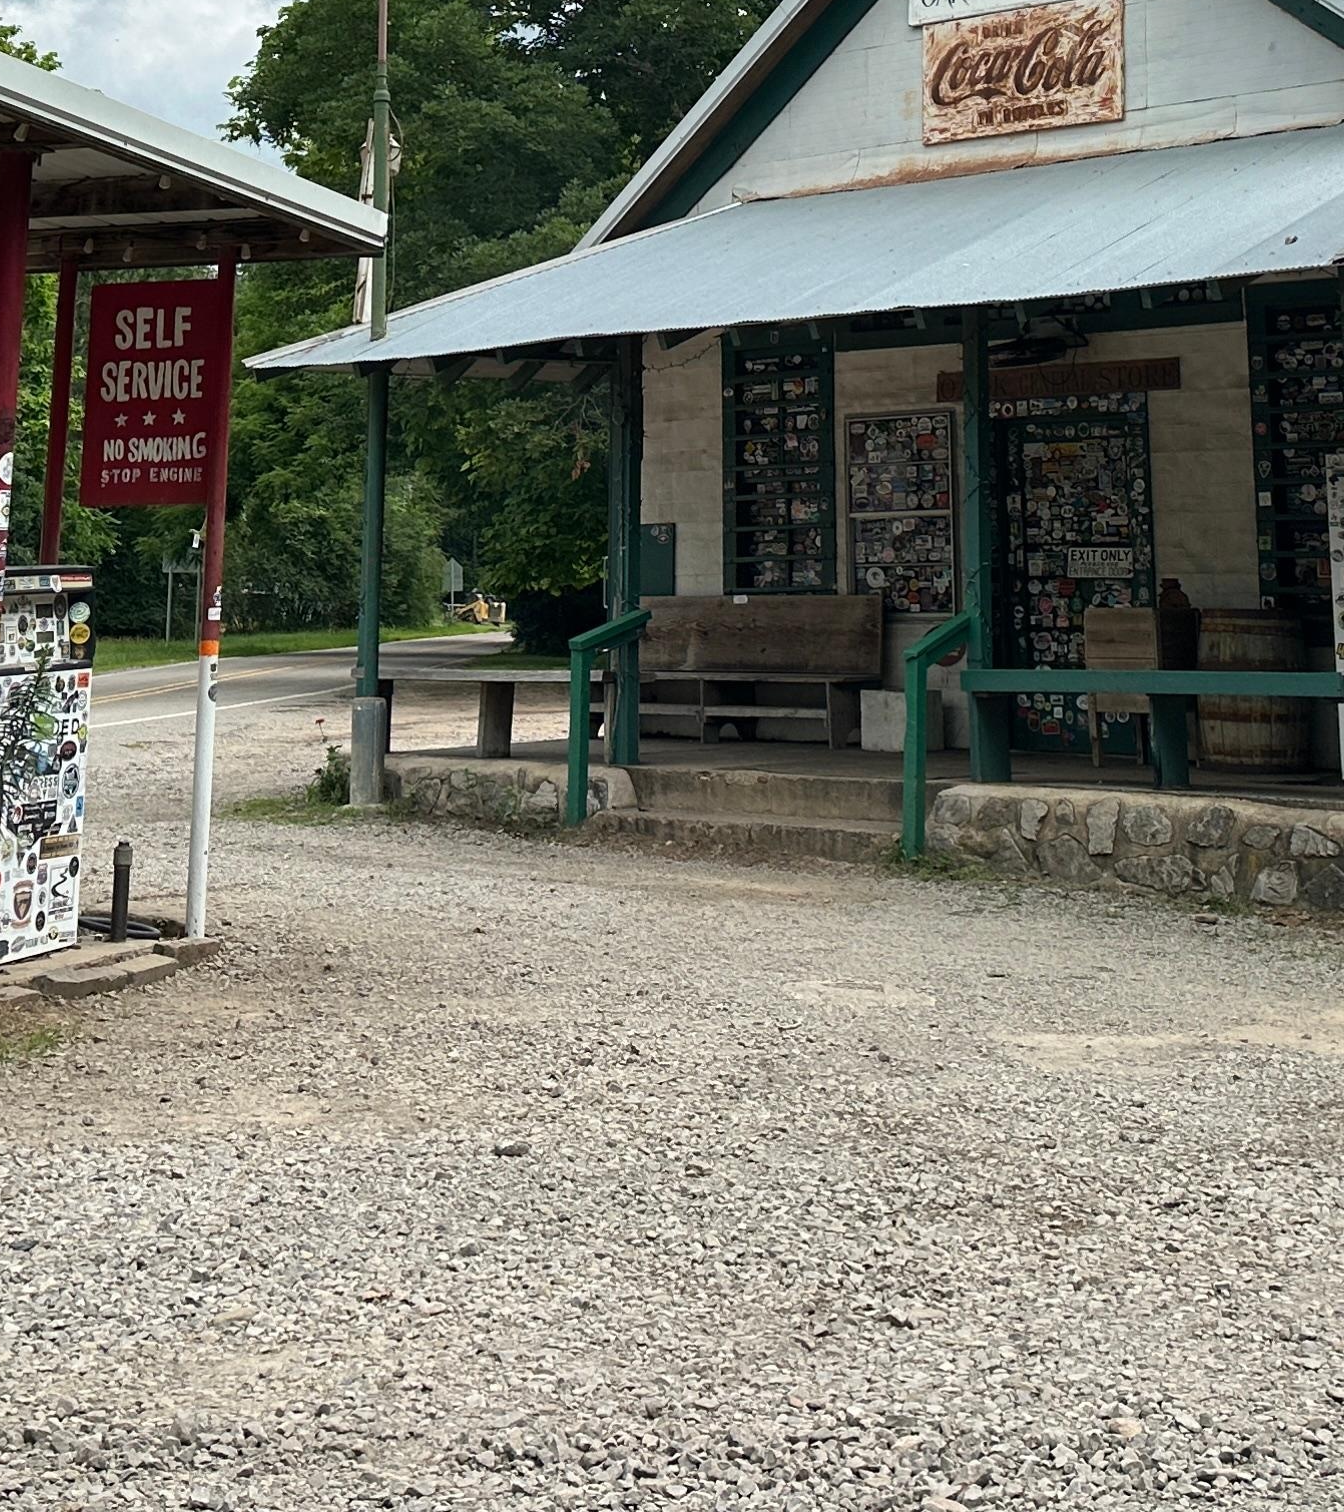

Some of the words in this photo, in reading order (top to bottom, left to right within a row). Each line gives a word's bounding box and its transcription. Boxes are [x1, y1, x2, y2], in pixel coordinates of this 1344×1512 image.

[114, 306, 193, 350] SELF
[100, 359, 205, 402] SERVICE
[103, 438, 125, 462] NO
[127, 431, 207, 463] SMOKING
[100, 467, 141, 484] STOP
[149, 466, 203, 483] ENGINE
[1070, 549, 1098, 561] EXIT
[1101, 549, 1131, 561] ONLY
